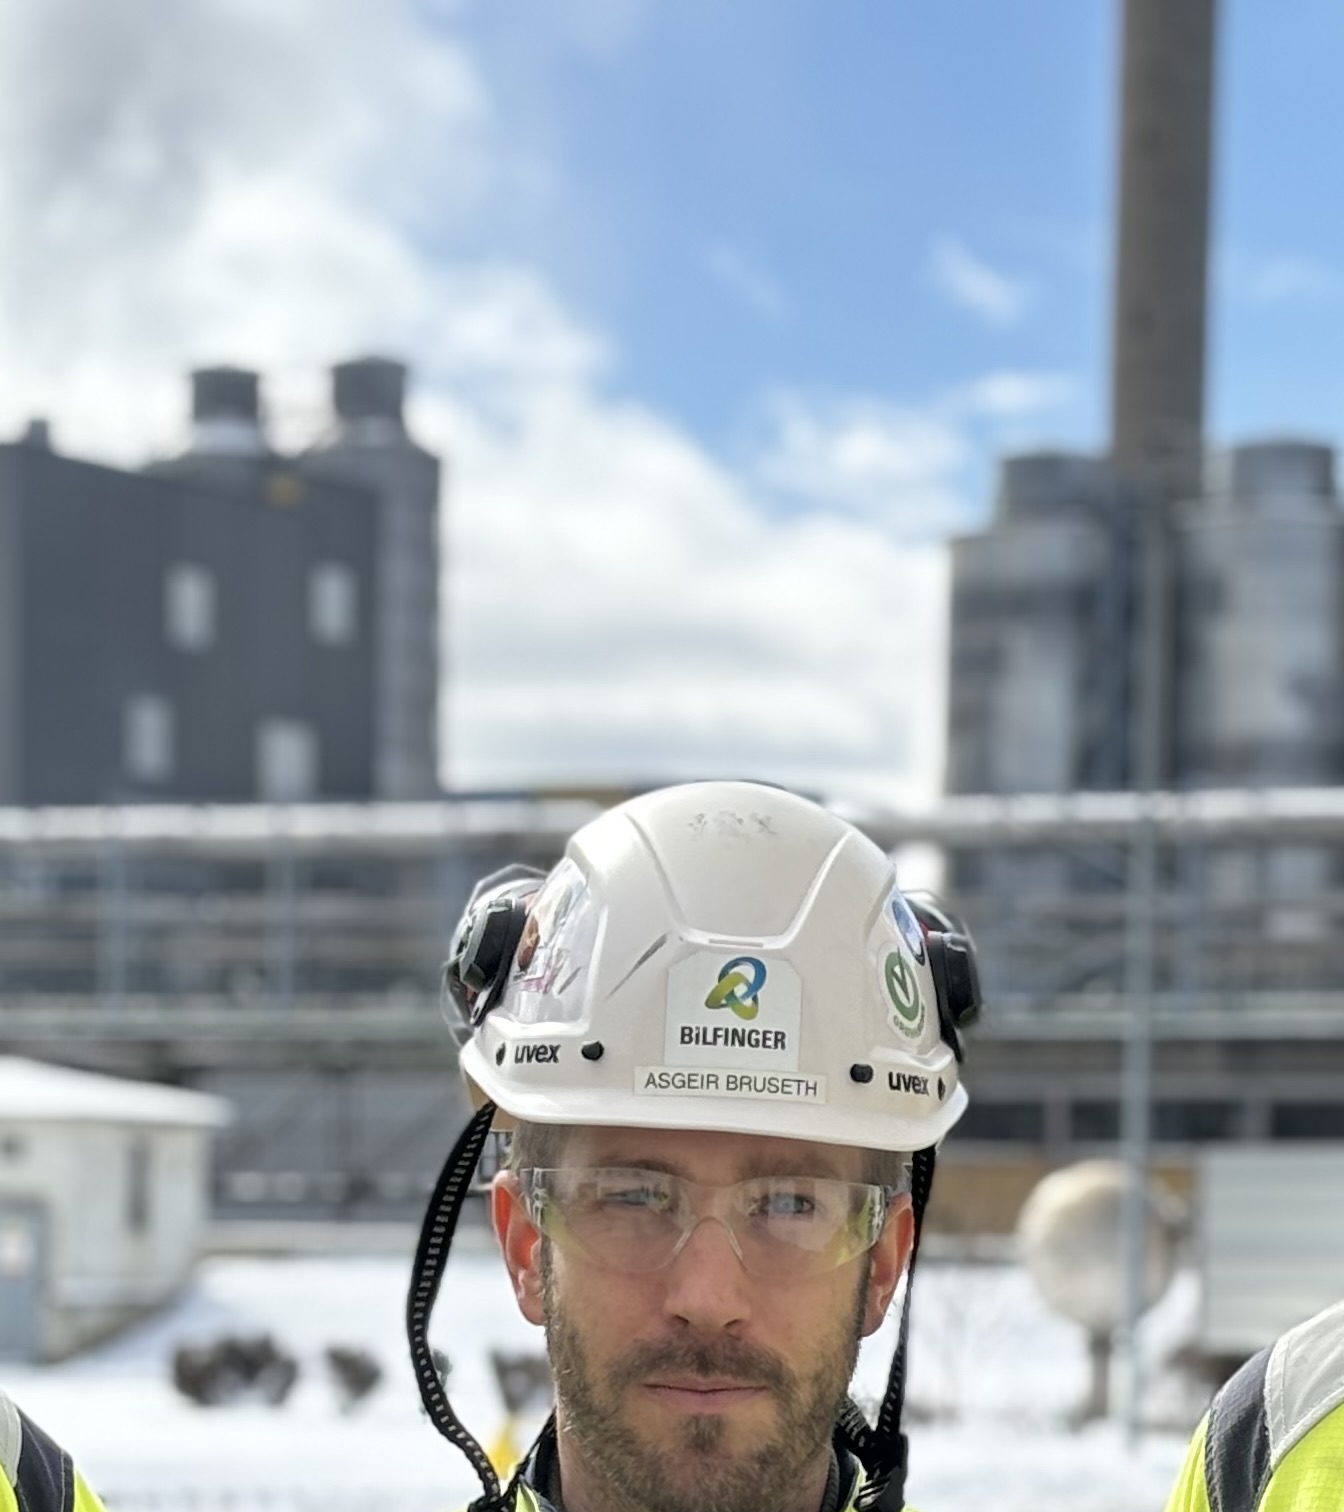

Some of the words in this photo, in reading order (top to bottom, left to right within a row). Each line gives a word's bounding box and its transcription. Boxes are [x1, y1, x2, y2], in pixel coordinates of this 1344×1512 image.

[514, 1044, 561, 1064] uvex
[644, 1072, 719, 1090] ASGEIR
[726, 1074, 818, 1097] BRUSETH
[888, 1071, 929, 1096] uvex
